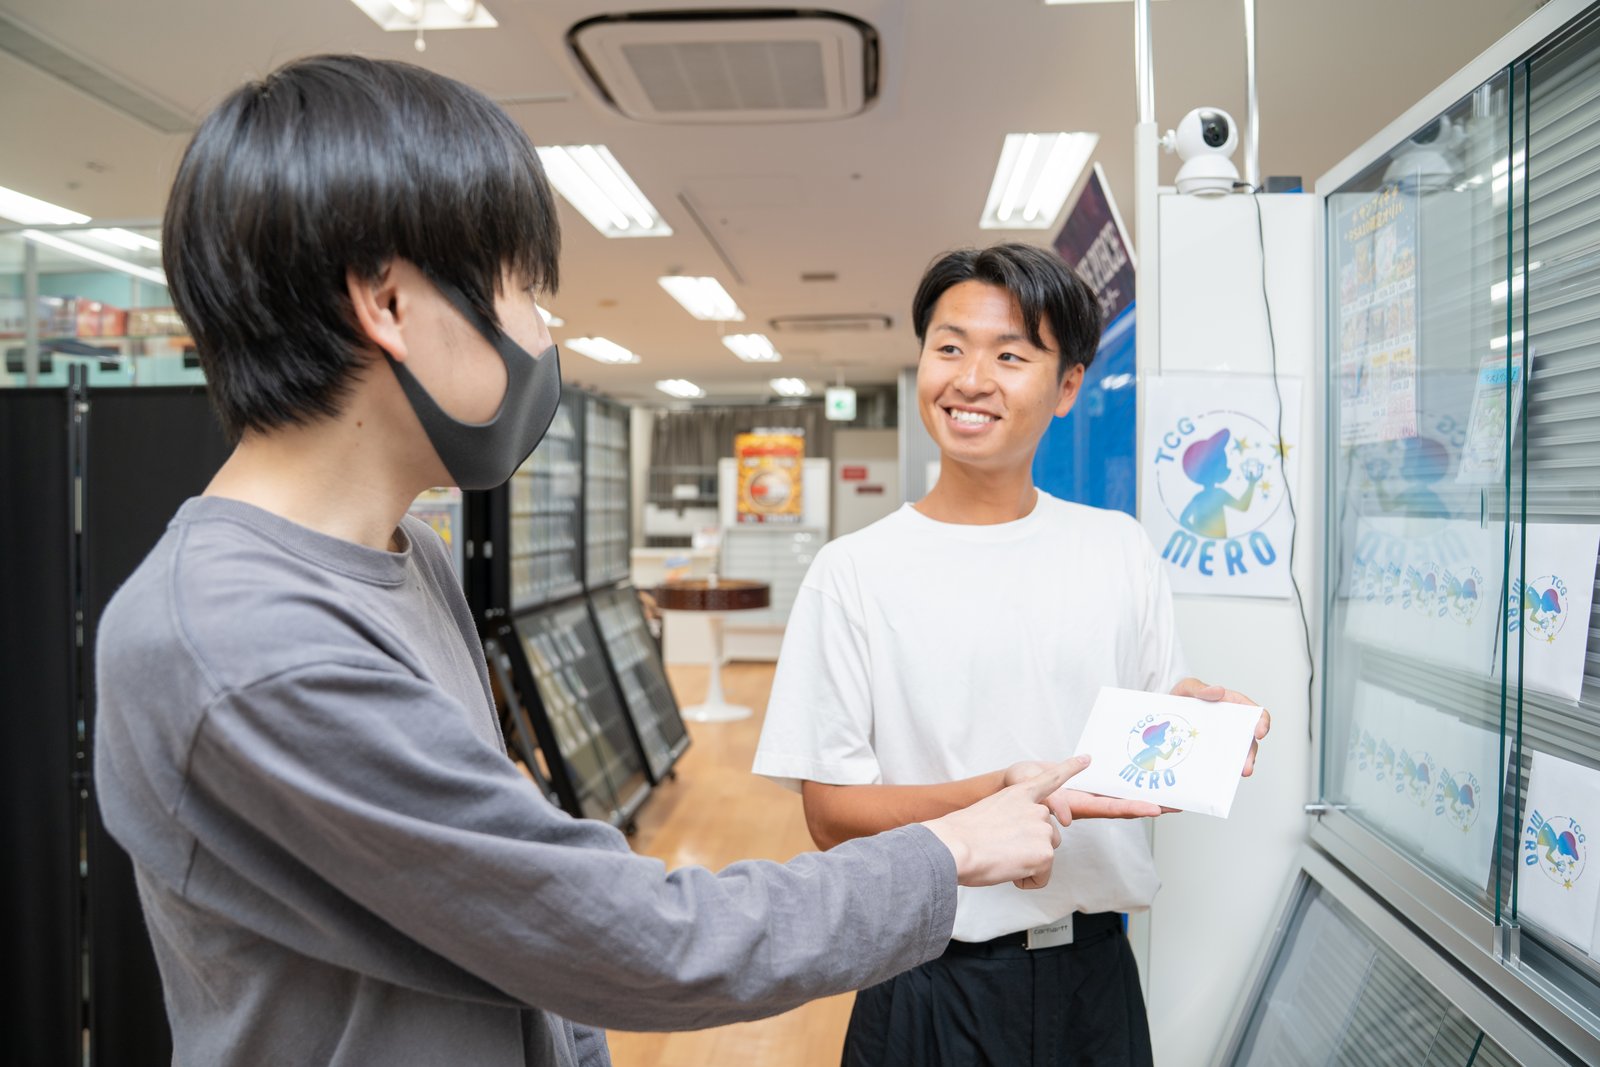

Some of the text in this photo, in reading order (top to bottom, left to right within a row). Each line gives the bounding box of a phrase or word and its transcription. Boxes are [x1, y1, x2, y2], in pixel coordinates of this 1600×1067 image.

[1154, 418, 1195, 464] TCG
[1161, 530, 1276, 576] MERO
[1438, 568, 1453, 618] MERO
[1552, 575, 1567, 597] TCG
[1130, 715, 1154, 734] TCG
[1119, 764, 1175, 789] MERO
[1435, 768, 1450, 816] MERO
[1467, 772, 1481, 794] TCG
[1525, 810, 1543, 866] MERO
[1569, 818, 1586, 843] TCG
